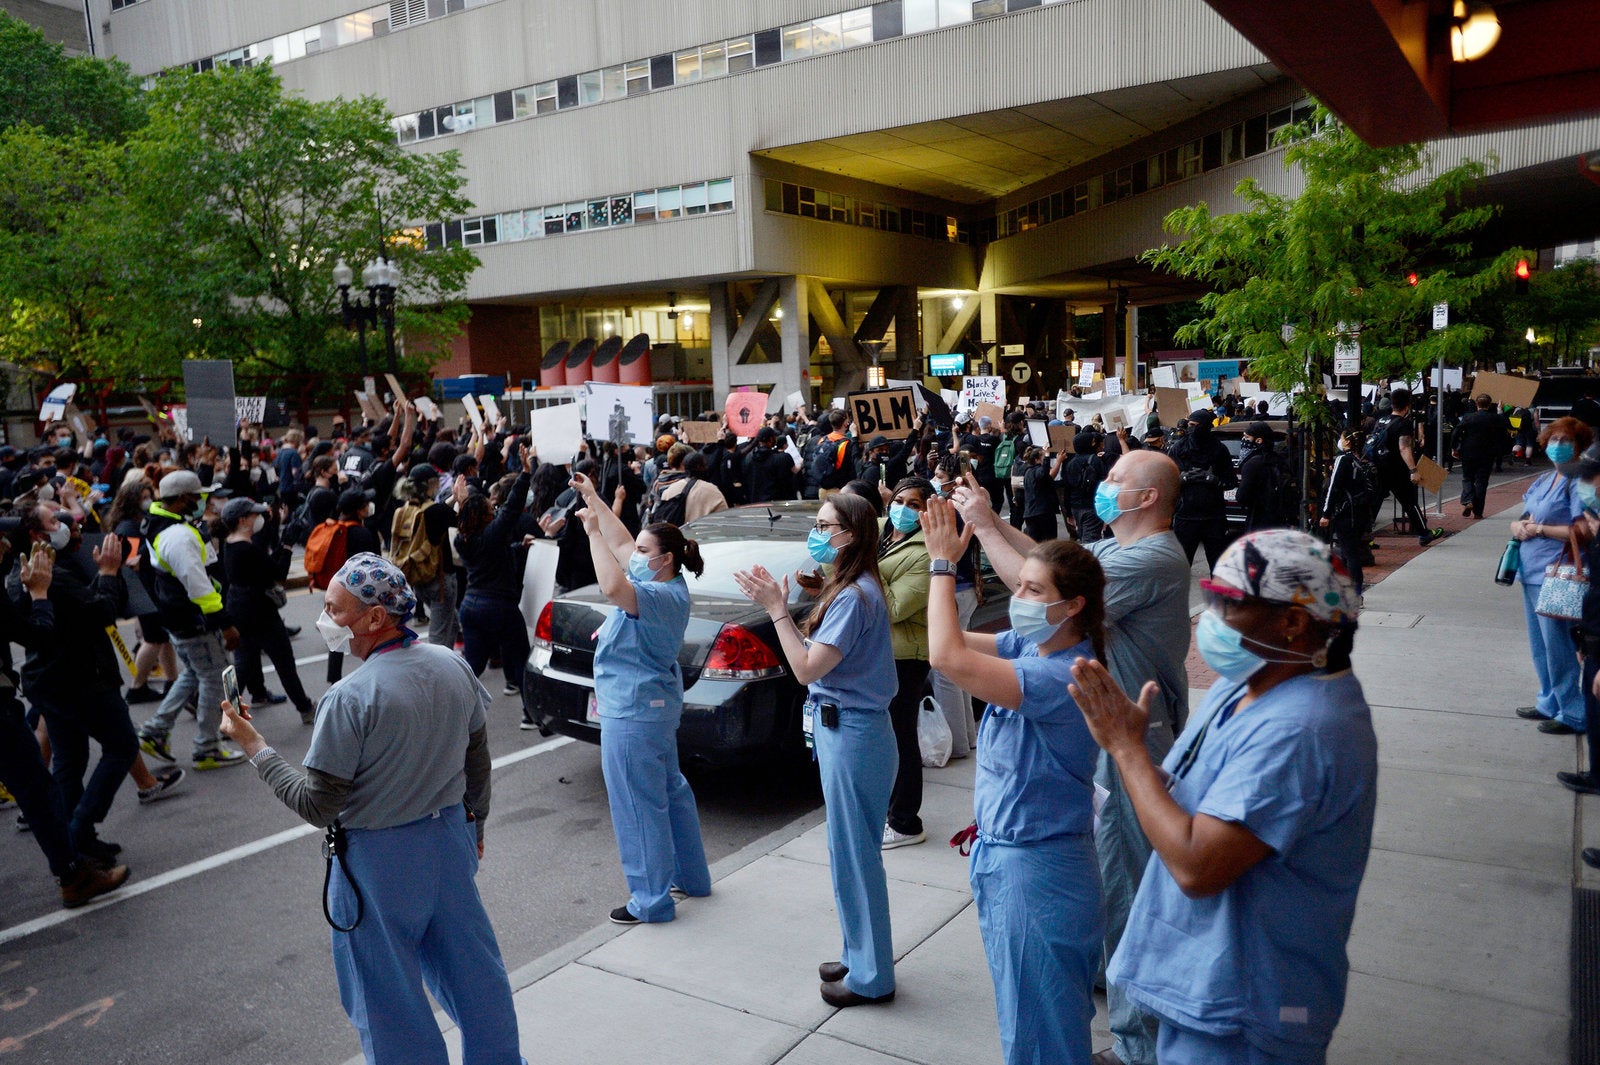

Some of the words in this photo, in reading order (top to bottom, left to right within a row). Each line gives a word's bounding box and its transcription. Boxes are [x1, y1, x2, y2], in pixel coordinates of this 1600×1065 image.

[1015, 366, 1027, 379] T
[966, 378, 990, 389] Black
[973, 389, 996, 398] Lives
[854, 395, 914, 435] BLM
[111, 629, 132, 665] SHOOT
